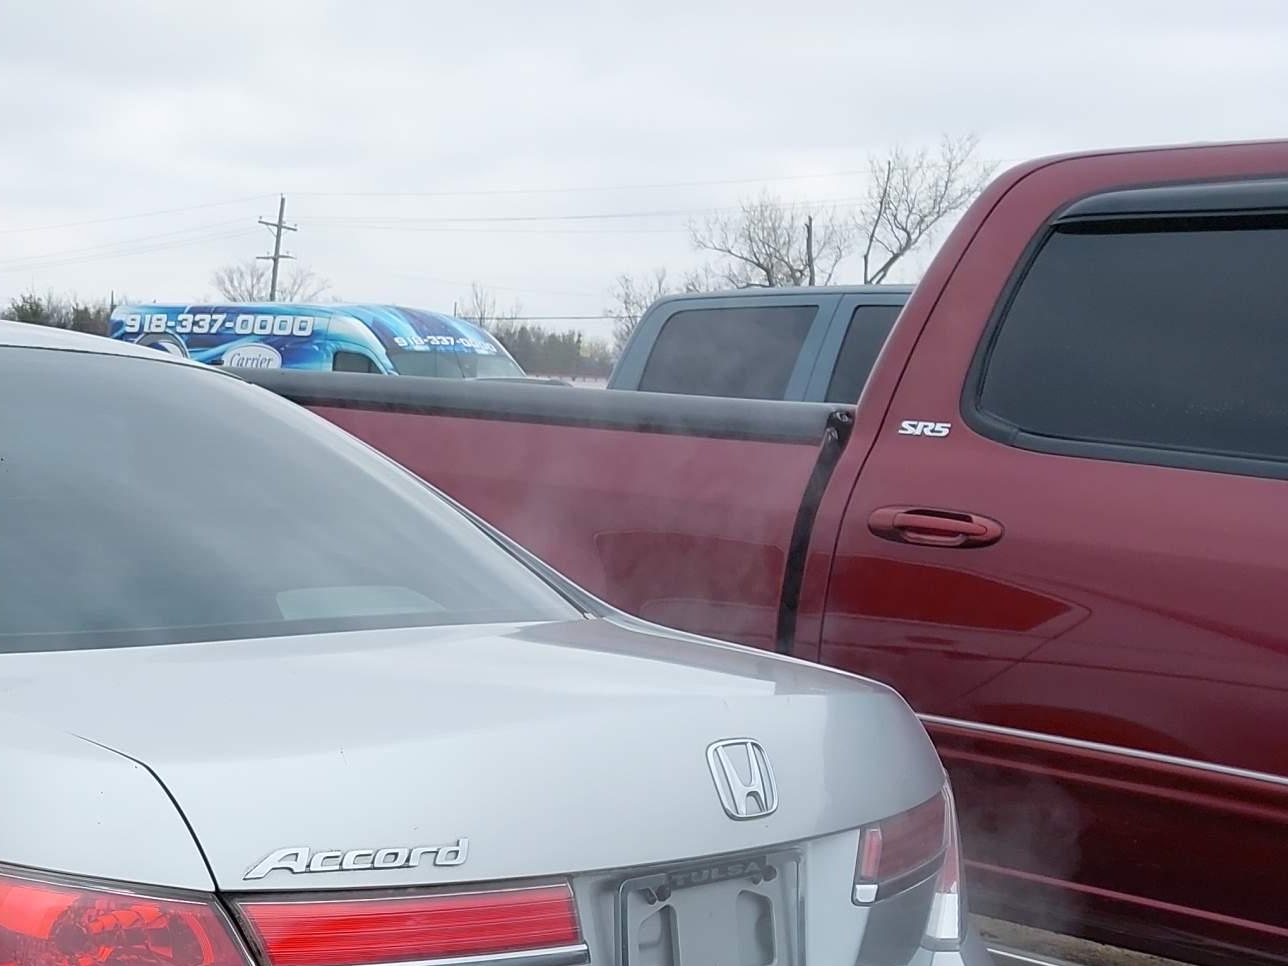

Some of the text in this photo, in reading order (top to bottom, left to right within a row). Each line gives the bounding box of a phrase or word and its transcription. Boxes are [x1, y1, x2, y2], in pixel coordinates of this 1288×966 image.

[125, 313, 314, 337] 918-337-0000
[229, 352, 273, 369] Carrier
[898, 420, 952, 437] SR5
[242, 837, 470, 881] Accord
[674, 861, 762, 887] TULSA
